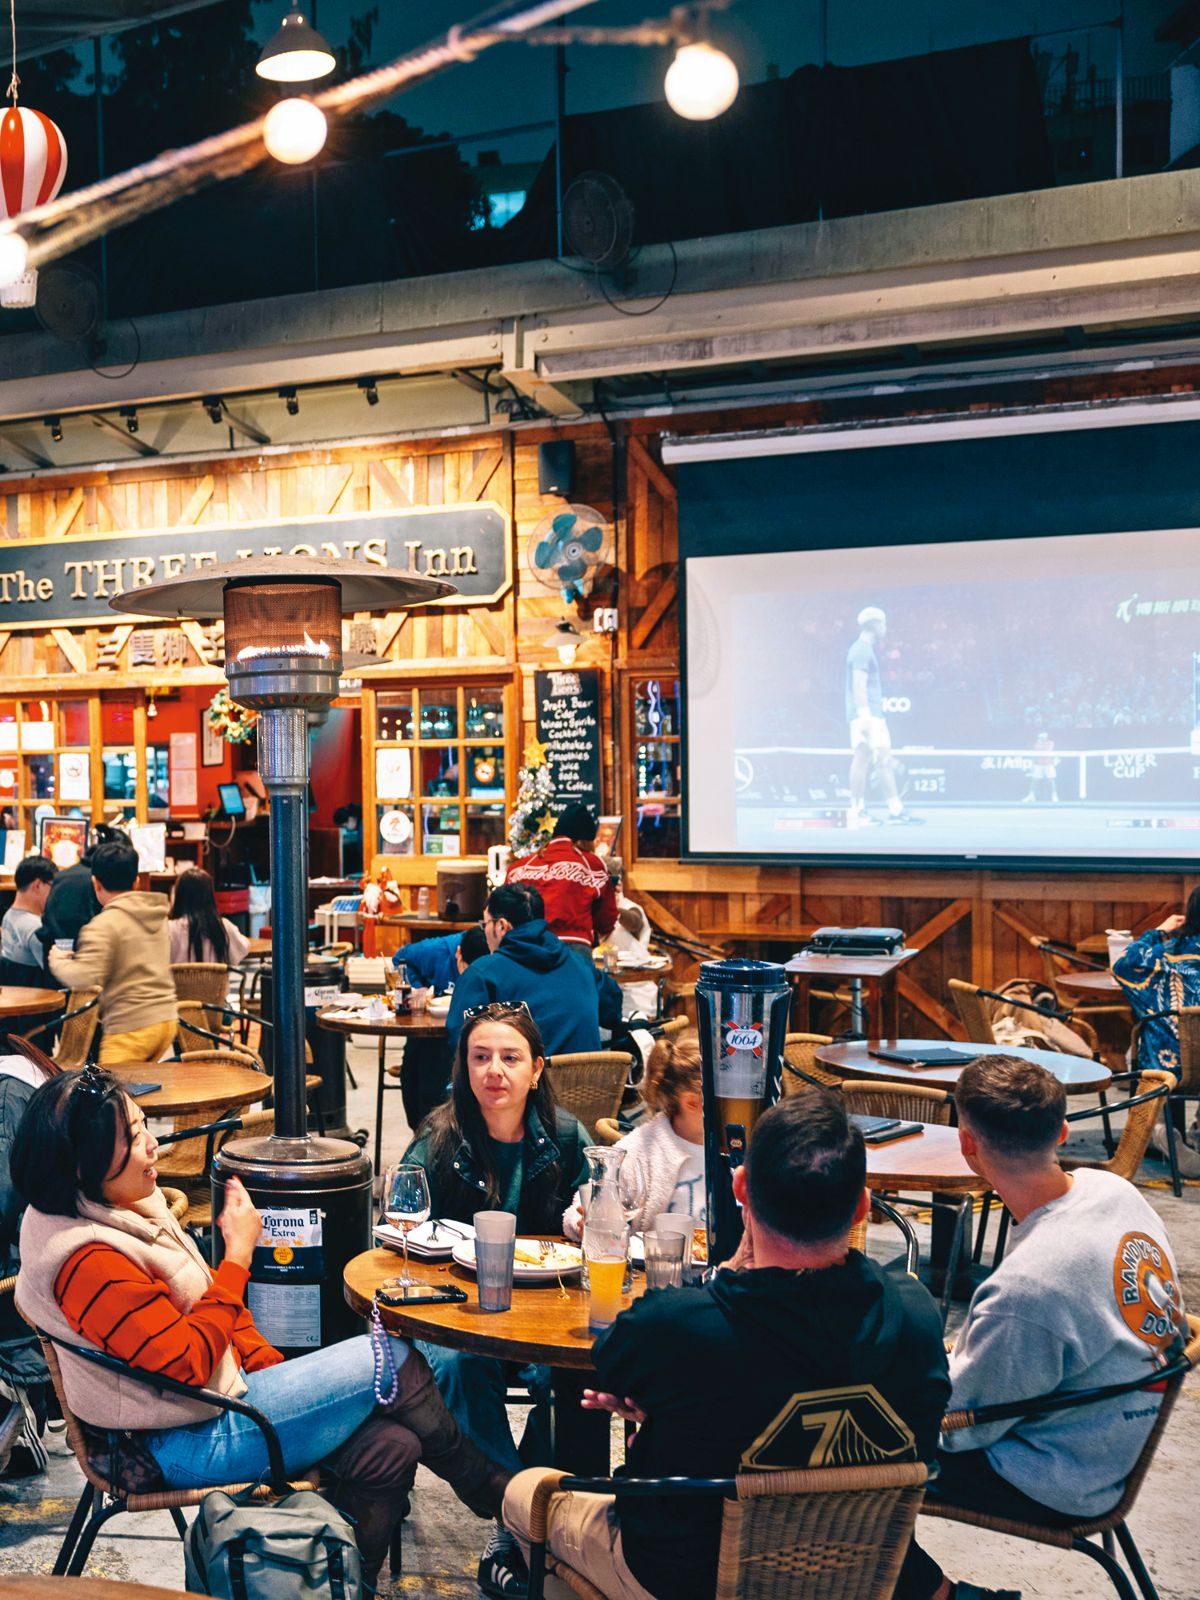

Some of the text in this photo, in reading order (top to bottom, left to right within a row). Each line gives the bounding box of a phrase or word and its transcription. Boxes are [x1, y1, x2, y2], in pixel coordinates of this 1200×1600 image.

[404, 540, 477, 577] Inn
[570, 696, 594, 709] Beer
[1103, 754, 1157, 767] LAVER
[1113, 766, 1146, 778] CUP
[565, 780, 593, 791] Coffee
[549, 861, 609, 889] Blood
[731, 1034, 757, 1045] 1664
[261, 1215, 305, 1231] Corona
[271, 1227, 296, 1237] Extra
[1122, 1238, 1161, 1305] RANDY'S
[801, 1409, 842, 1467] 7
